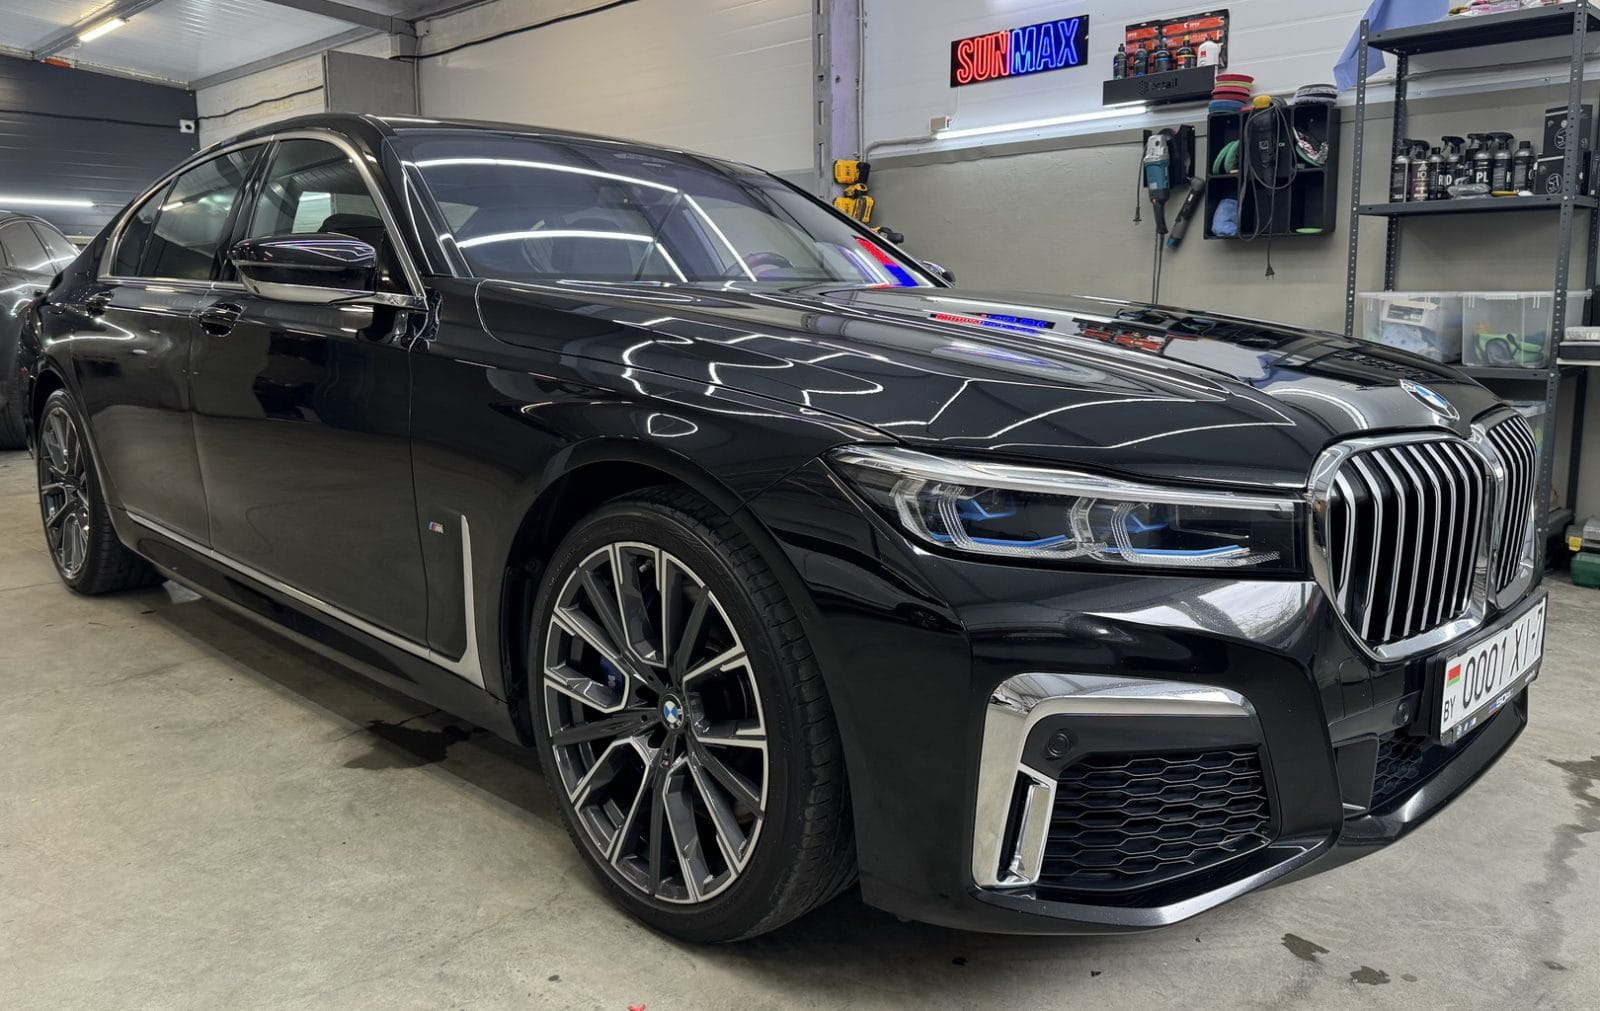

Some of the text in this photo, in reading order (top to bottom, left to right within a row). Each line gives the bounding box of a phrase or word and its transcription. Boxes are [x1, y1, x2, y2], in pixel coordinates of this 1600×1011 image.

[956, 18, 1079, 84] SUNMAX
[1462, 636, 1507, 709] 0001
[1443, 696, 1456, 722] BY
